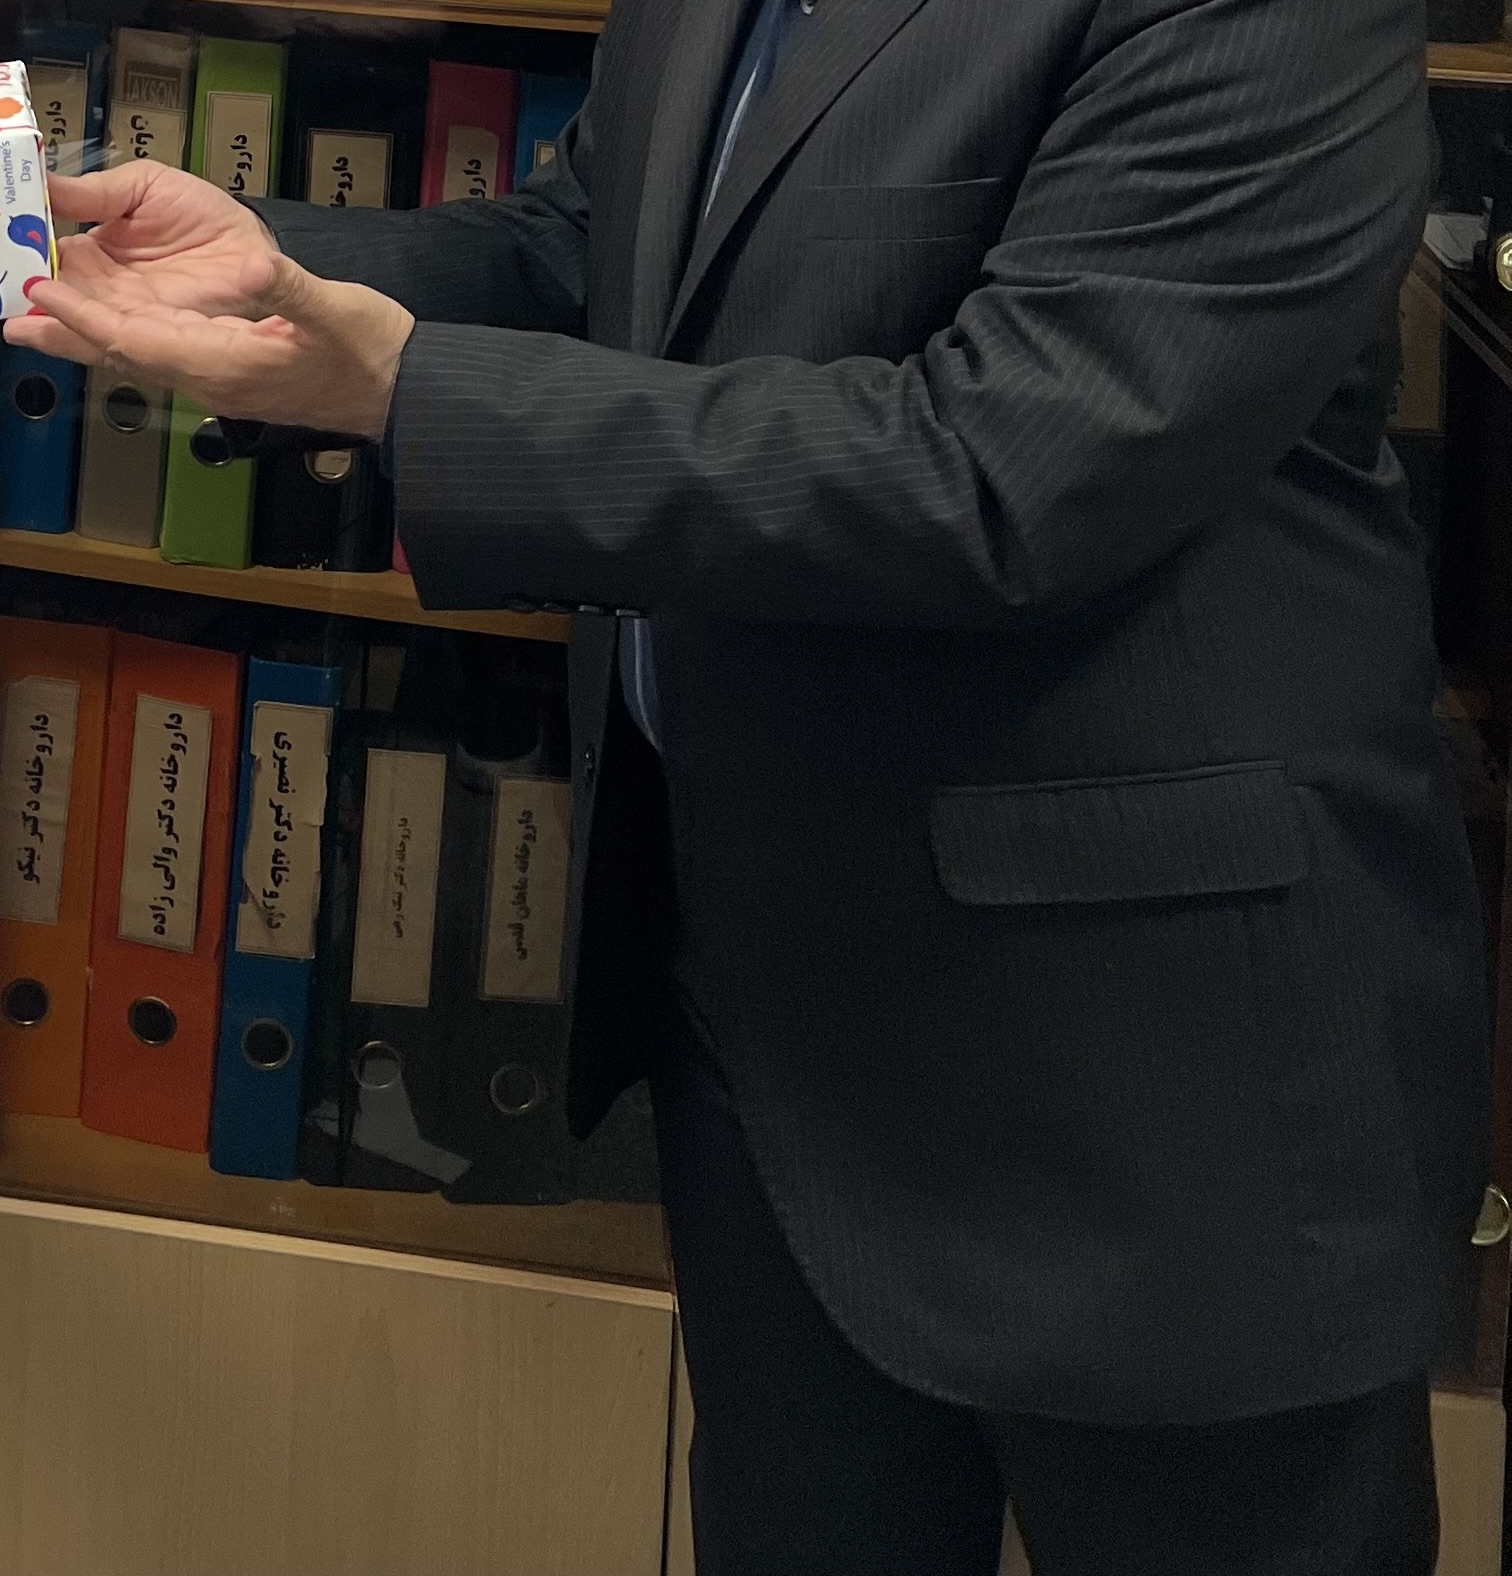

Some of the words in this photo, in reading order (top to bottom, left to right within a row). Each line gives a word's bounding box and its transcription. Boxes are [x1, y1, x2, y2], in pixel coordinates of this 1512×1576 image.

[0, 140, 17, 205] Valentine's
[20, 159, 33, 182] Day
[228, 134, 253, 197] داروخا
[329, 156, 353, 208] داروخا
[25, 713, 54, 795] داروخانه
[159, 712, 188, 793] داروخانه
[21, 799, 44, 843] دکتر
[156, 799, 180, 843] دکتر
[269, 797, 293, 842] دکتر
[16, 846, 41, 884] نیکو
[152, 846, 178, 891] والی
[262, 847, 291, 930] داروخانه
[148, 896, 175, 936] زاده
